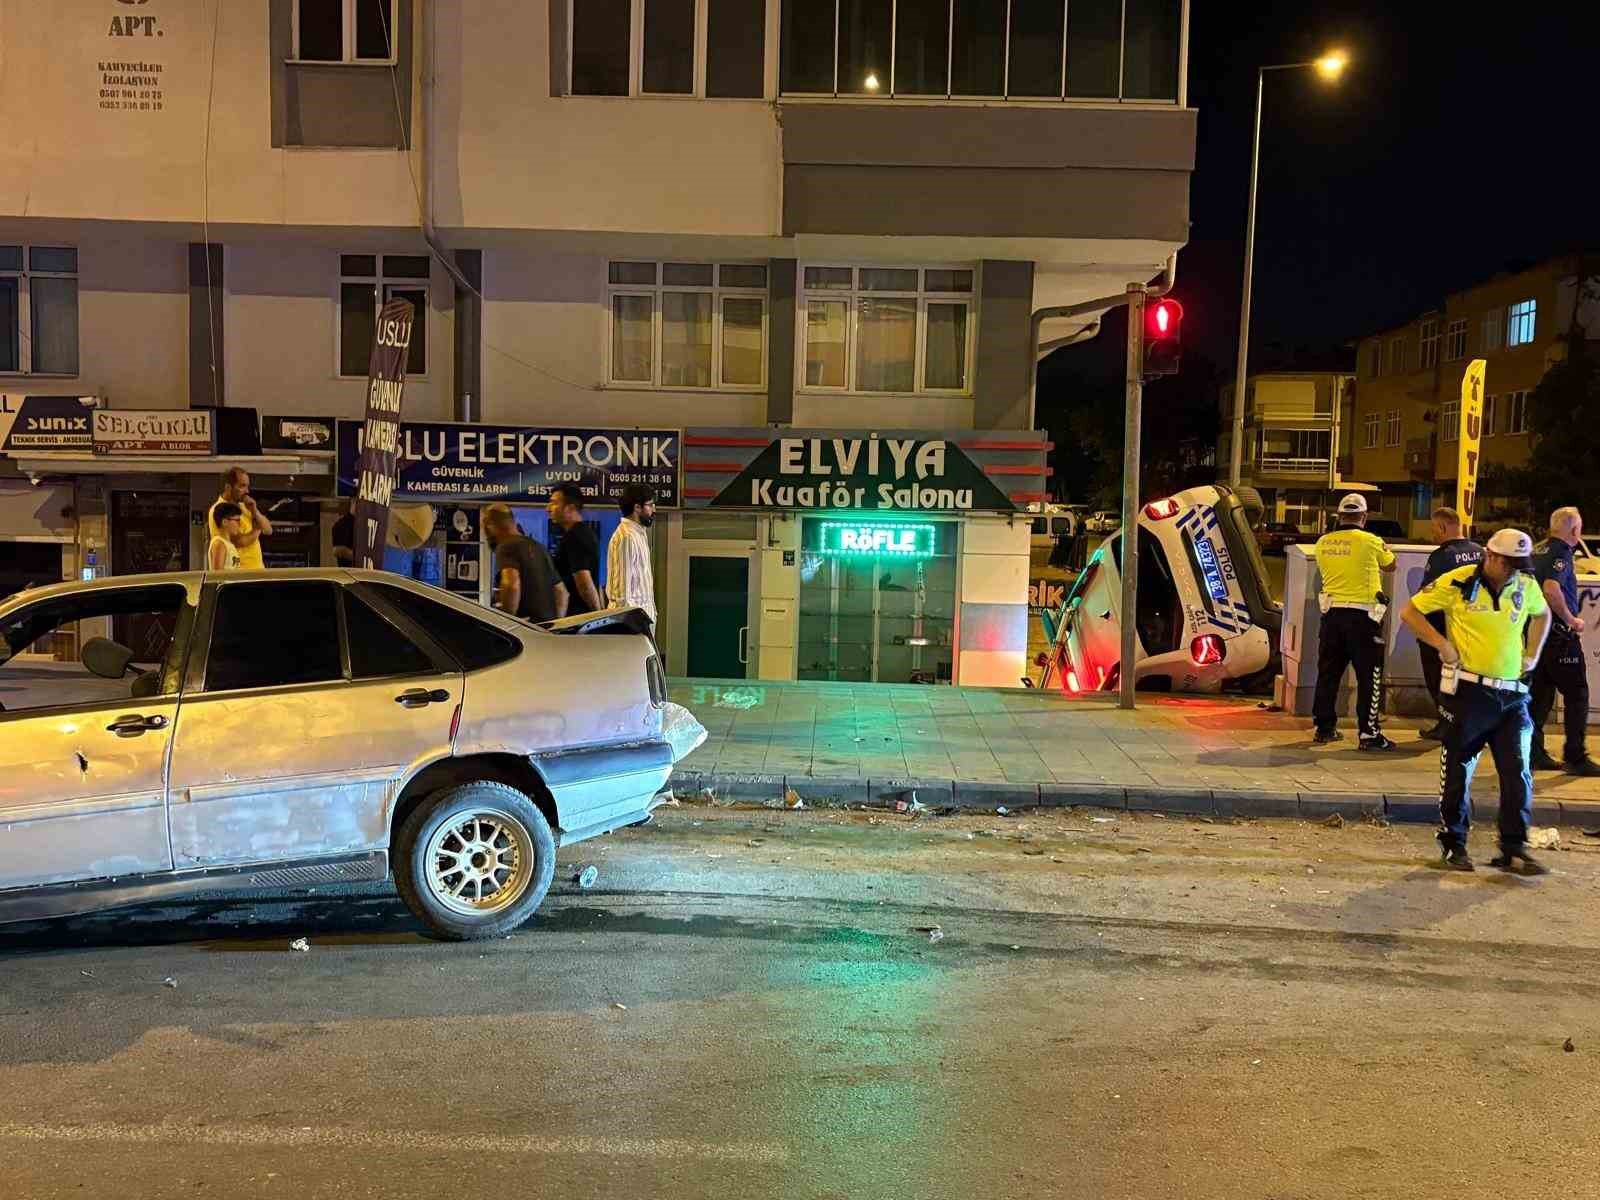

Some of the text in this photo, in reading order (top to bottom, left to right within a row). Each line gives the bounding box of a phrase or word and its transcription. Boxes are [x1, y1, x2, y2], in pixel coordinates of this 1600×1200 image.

[108, 15, 163, 36] APT.
[377, 318, 412, 348] USLU
[779, 432, 946, 481] ELVİYA
[431, 465, 484, 478] GÜVENLİK
[545, 471, 581, 482] UYDU
[359, 470, 393, 507] ALARM
[407, 481, 461, 493] KAMERASI
[472, 483, 508, 495] ALARM
[752, 478, 973, 510] Kuaför Salonu
[841, 527, 916, 552] RÖFLE
